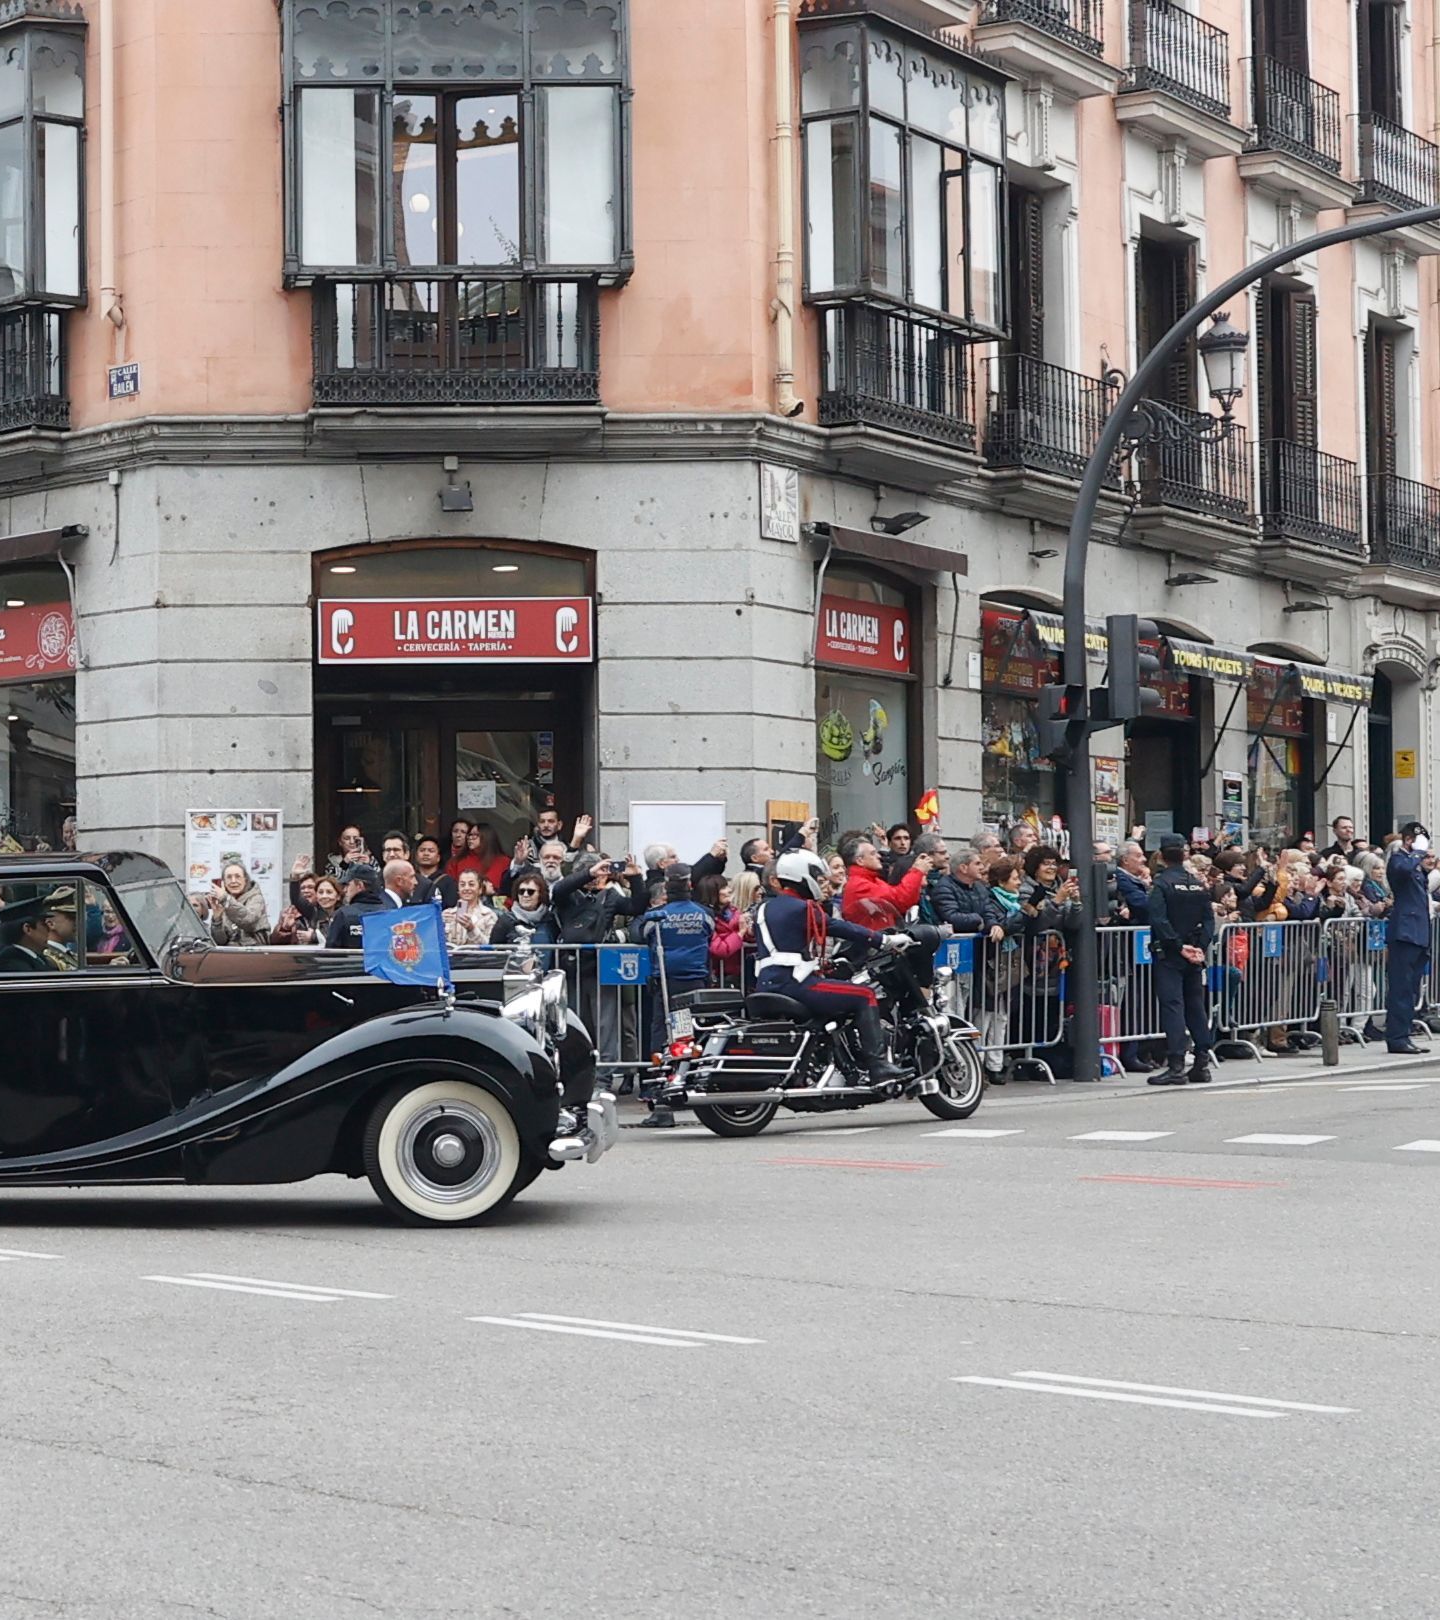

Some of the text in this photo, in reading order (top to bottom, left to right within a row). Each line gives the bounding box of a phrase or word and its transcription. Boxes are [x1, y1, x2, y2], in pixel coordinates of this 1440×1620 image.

[118, 365, 137, 376] CALLE
[766, 520, 796, 541] MAYOR
[394, 609, 515, 640] LA CARMEN
[825, 608, 879, 643] LA CARMEN
[1172, 649, 1202, 668] TOURS
[1207, 656, 1243, 676] TICKETS
[1301, 675, 1326, 693] TOURS
[872, 760, 906, 786] Sangría
